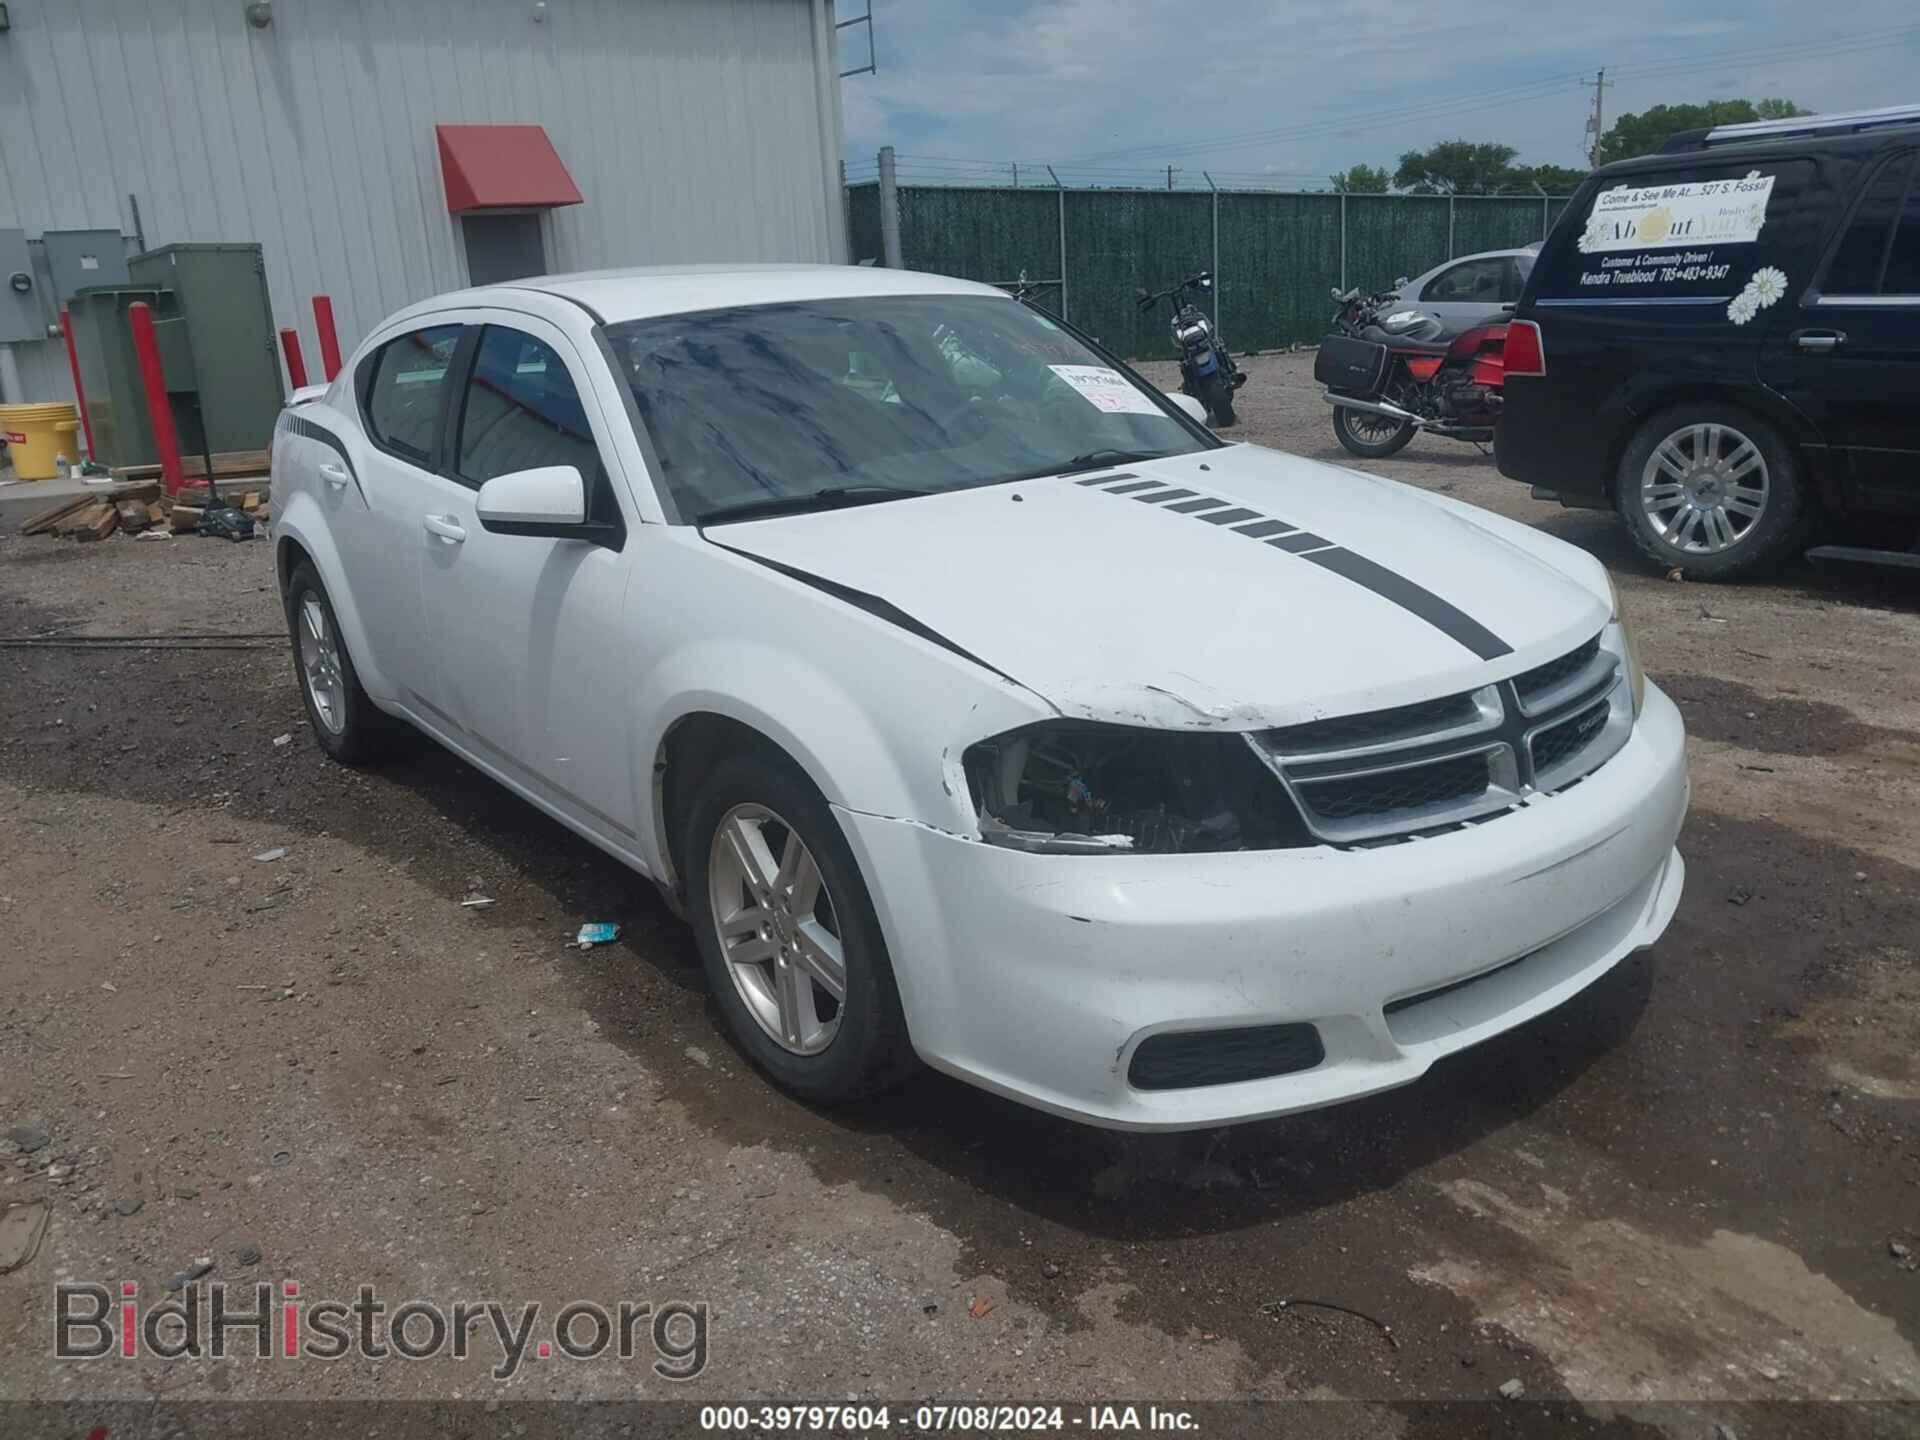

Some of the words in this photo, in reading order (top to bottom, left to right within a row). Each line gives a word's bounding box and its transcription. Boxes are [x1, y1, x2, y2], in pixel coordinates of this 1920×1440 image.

[1602, 194, 1630, 205] Come
[1632, 192, 1639, 202] &
[1641, 190, 1659, 201] See
[1661, 188, 1676, 199] Me
[1734, 180, 1768, 193] Fossil
[1601, 257, 1634, 268] Customer
[1635, 255, 1641, 266] &
[1642, 253, 1683, 266] Community
[1683, 252, 1708, 264] Driven
[1580, 271, 1611, 285] Kendra
[1612, 268, 1658, 284] Trueblood
